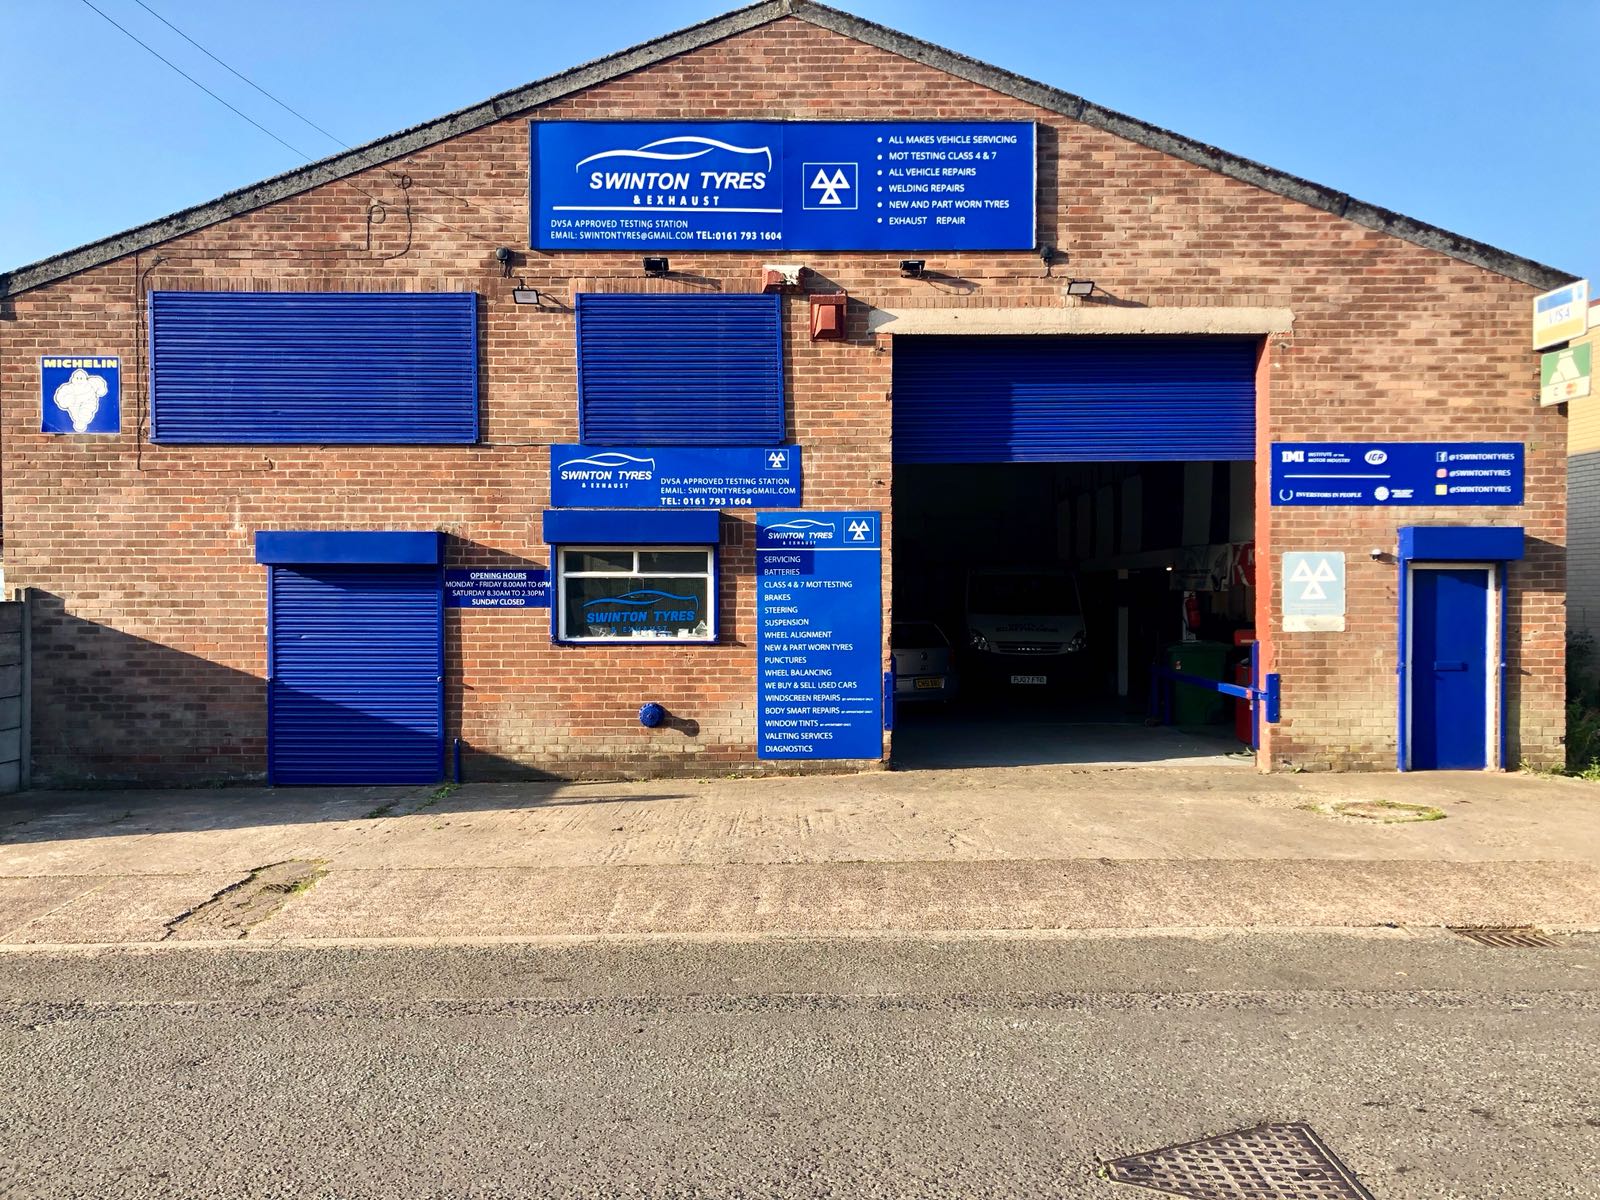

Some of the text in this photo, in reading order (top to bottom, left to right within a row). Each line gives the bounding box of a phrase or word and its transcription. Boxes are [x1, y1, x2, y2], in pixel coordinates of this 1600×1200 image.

[889, 136, 903, 144] ALL
[889, 152, 909, 160] MOT
[911, 152, 946, 160] TESTING
[906, 168, 940, 176] VEHICLE
[942, 168, 976, 176] REPAIRS
[590, 172, 766, 189] SWINTON TYRES
[889, 184, 964, 192] WELDING REPAIRS
[633, 195, 719, 206] & EXHAUST
[932, 200, 953, 208] PART
[955, 200, 982, 208] WORN
[984, 200, 1009, 208] TYRES
[620, 220, 653, 229] TESTING
[656, 220, 688, 228] STATION
[889, 217, 927, 225] EXHAUST
[551, 231, 577, 239] EMAIL:
[580, 232, 693, 240] SWINTONTYRES@GMAIL.COM
[741, 232, 757, 240] 793
[760, 232, 782, 240] 1604
[44, 360, 117, 368] MICHELIN
[561, 471, 652, 480] SWINTON TYRES
[587, 611, 695, 622] SWINTON TYRES
